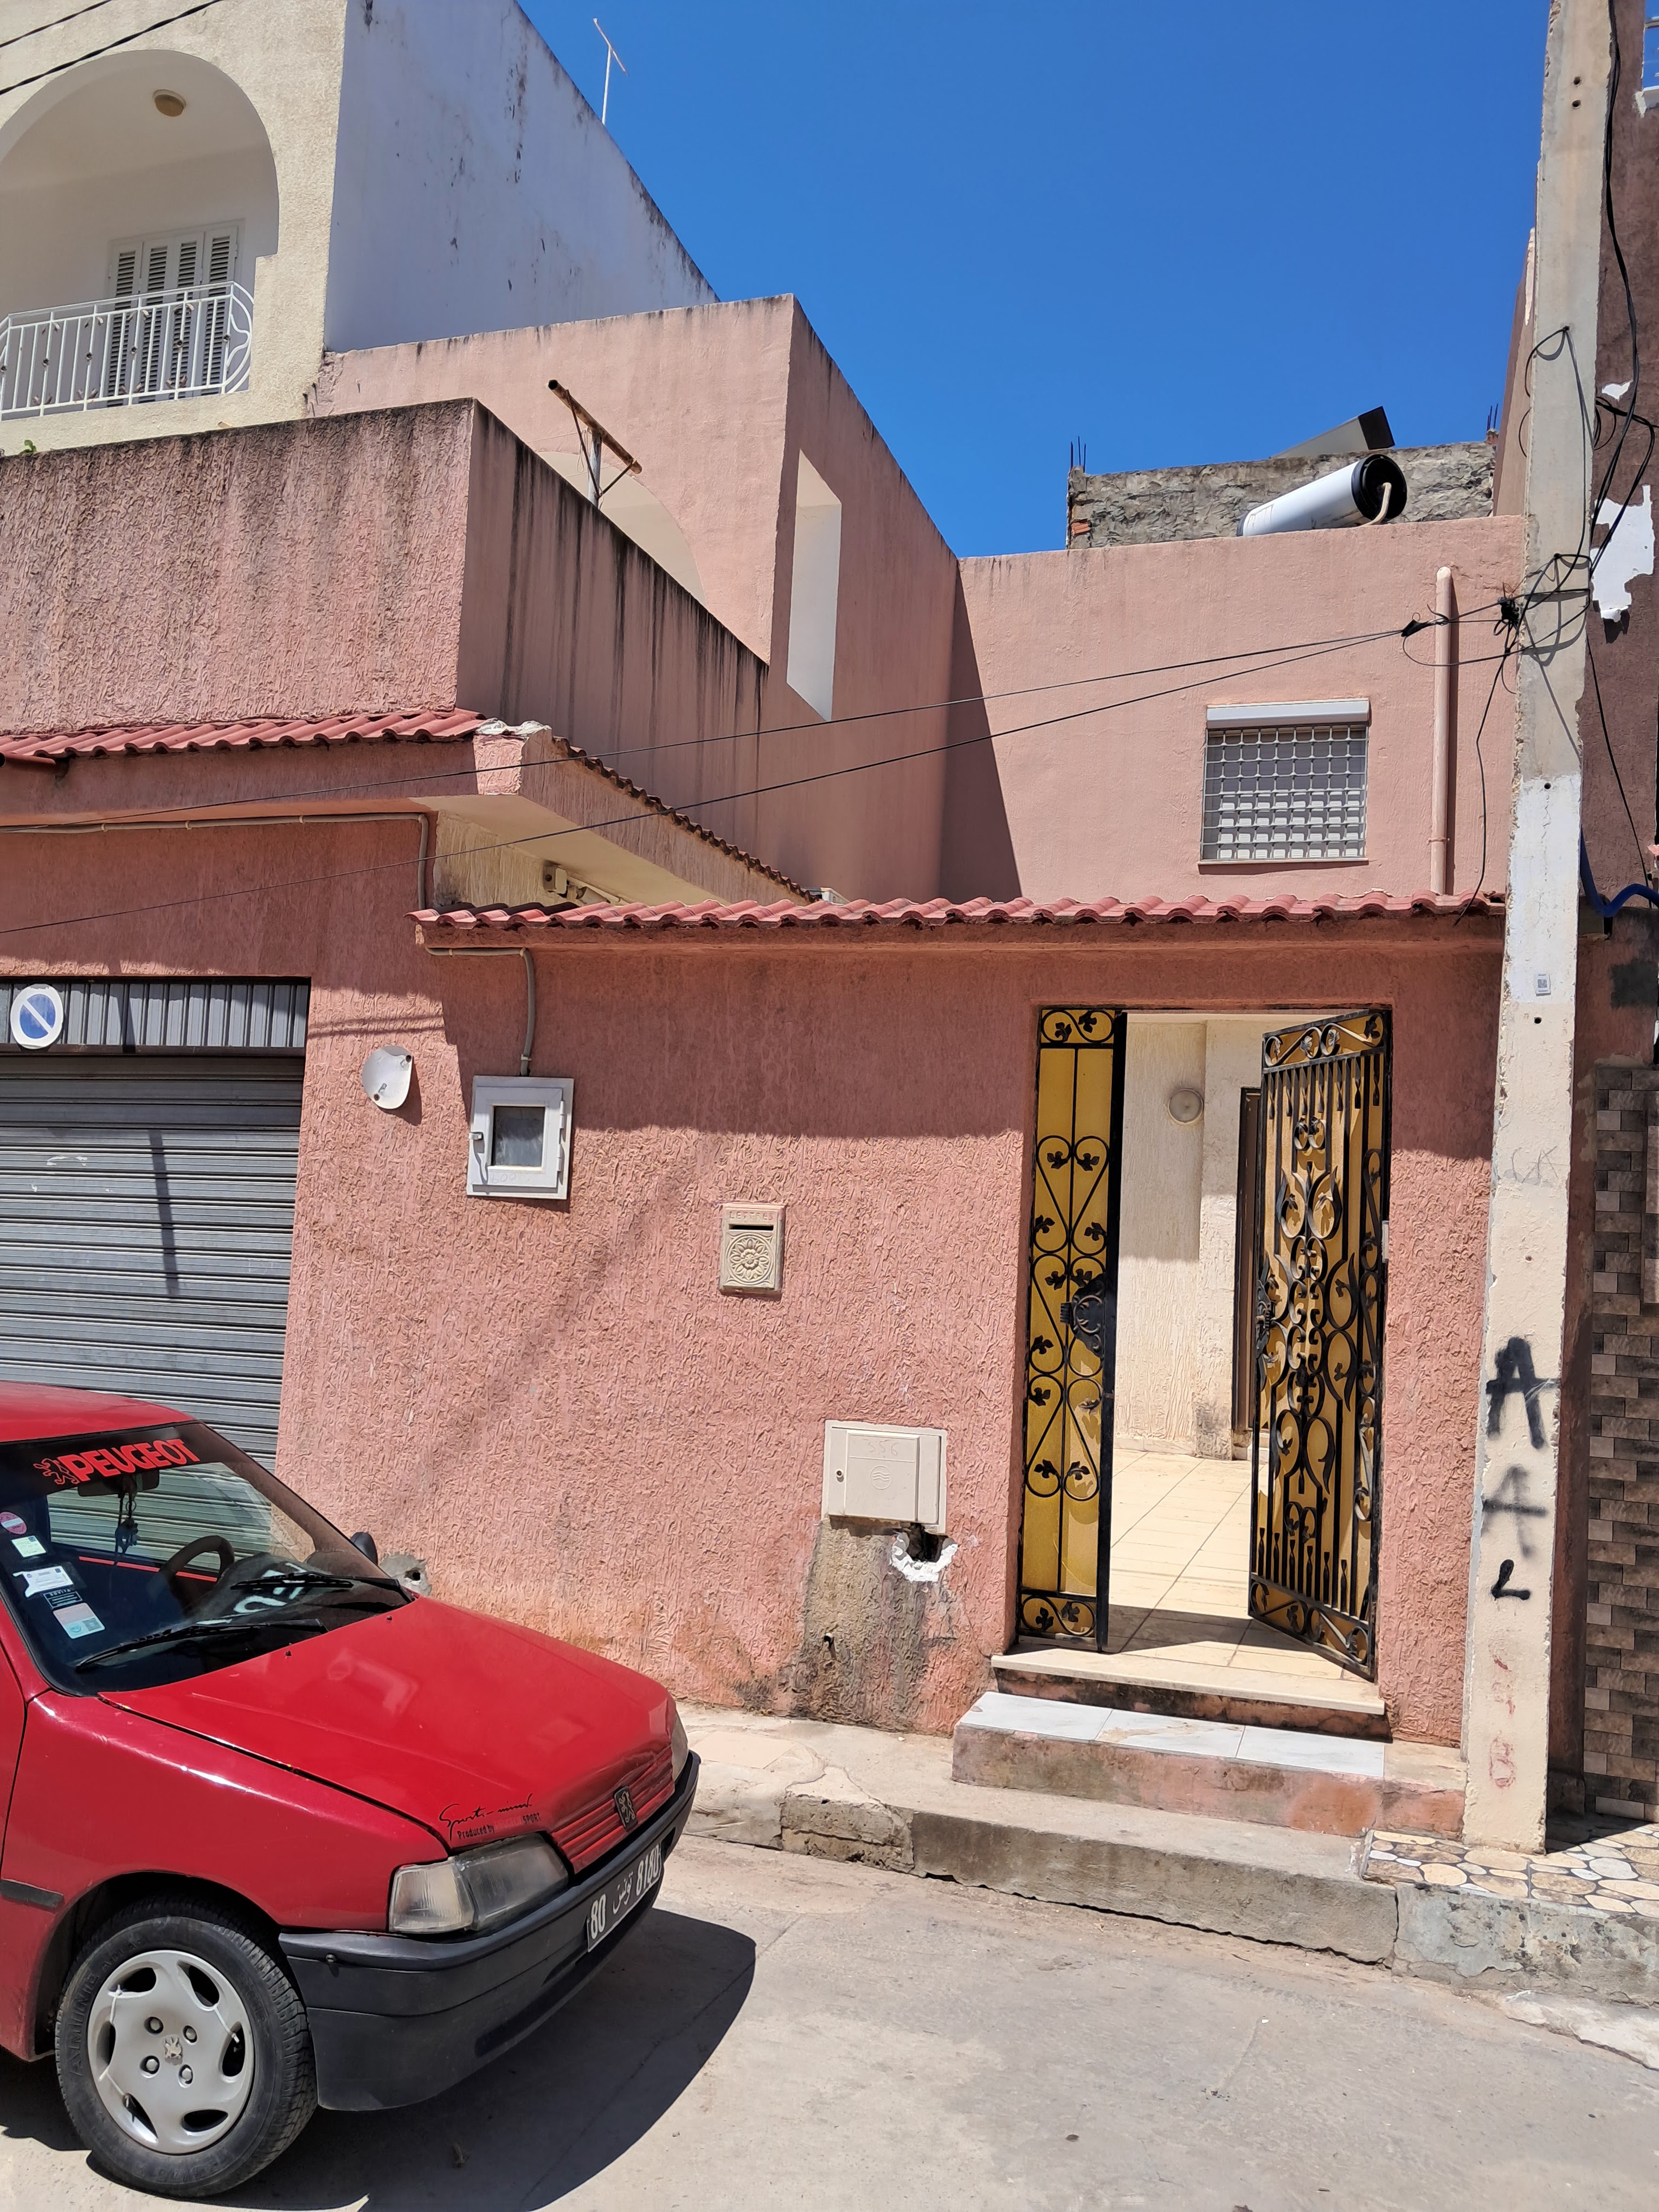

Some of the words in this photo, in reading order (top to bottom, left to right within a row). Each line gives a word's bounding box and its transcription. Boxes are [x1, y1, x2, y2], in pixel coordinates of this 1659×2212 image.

[729, 1211, 774, 1221] LETTRES
[57, 1439, 200, 1481] PEUGEOT
[863, 1438, 900, 1456] 356
[457, 1825, 487, 1839] Produced
[487, 1824, 494, 1834] by
[523, 1812, 541, 1824] SPORT
[591, 1894, 606, 1939] 80
[613, 1871, 633, 1914] تونس
[636, 1844, 659, 1896] 8180
